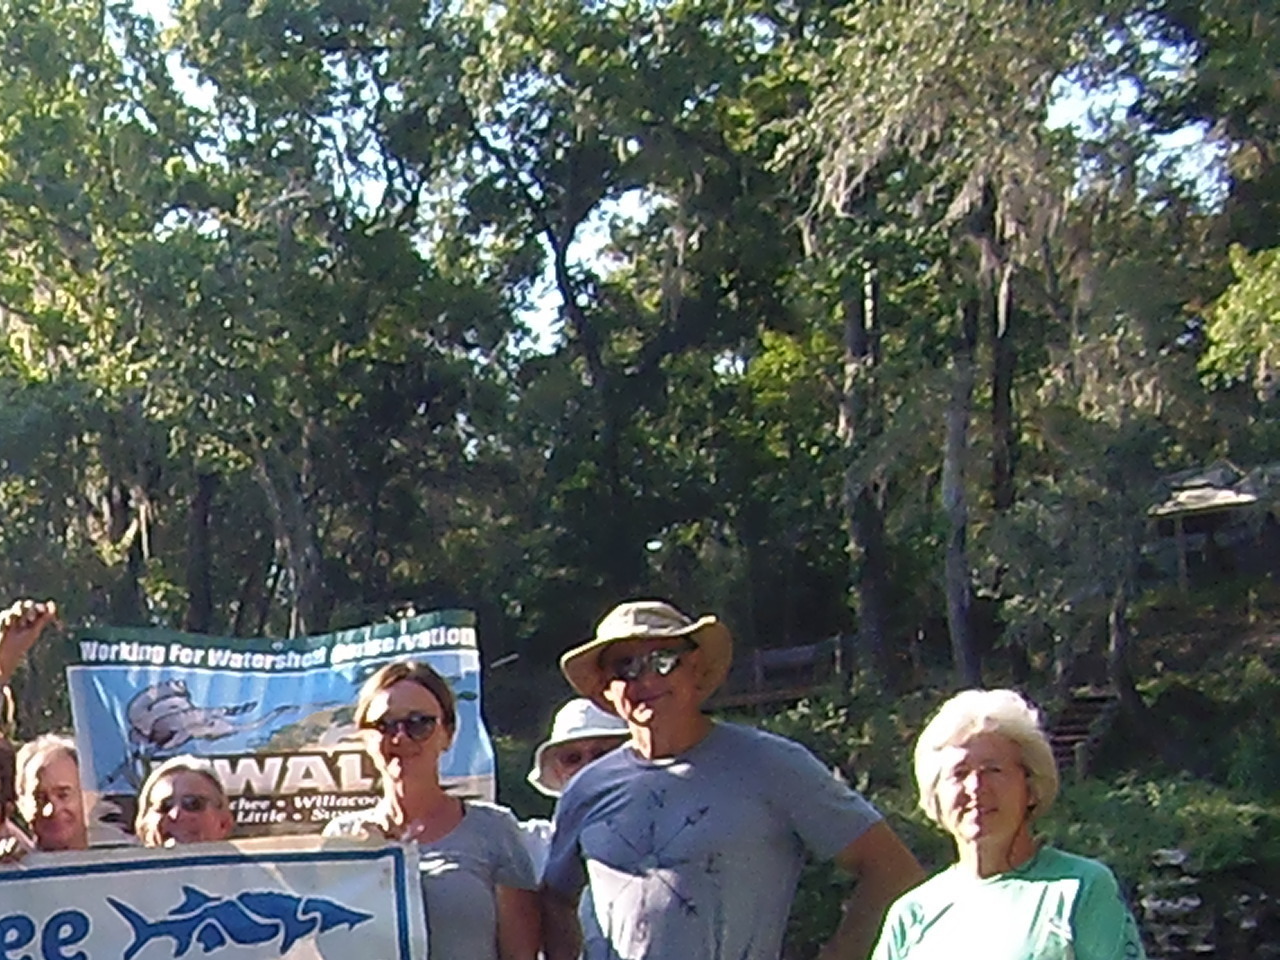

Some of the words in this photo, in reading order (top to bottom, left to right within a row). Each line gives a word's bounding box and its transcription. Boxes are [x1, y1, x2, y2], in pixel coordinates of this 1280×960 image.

[79, 640, 166, 664] Working
[169, 643, 205, 665] For
[207, 646, 327, 670] Watershed
[330, 626, 477, 664] Conservation
[236, 810, 287, 824] Little
